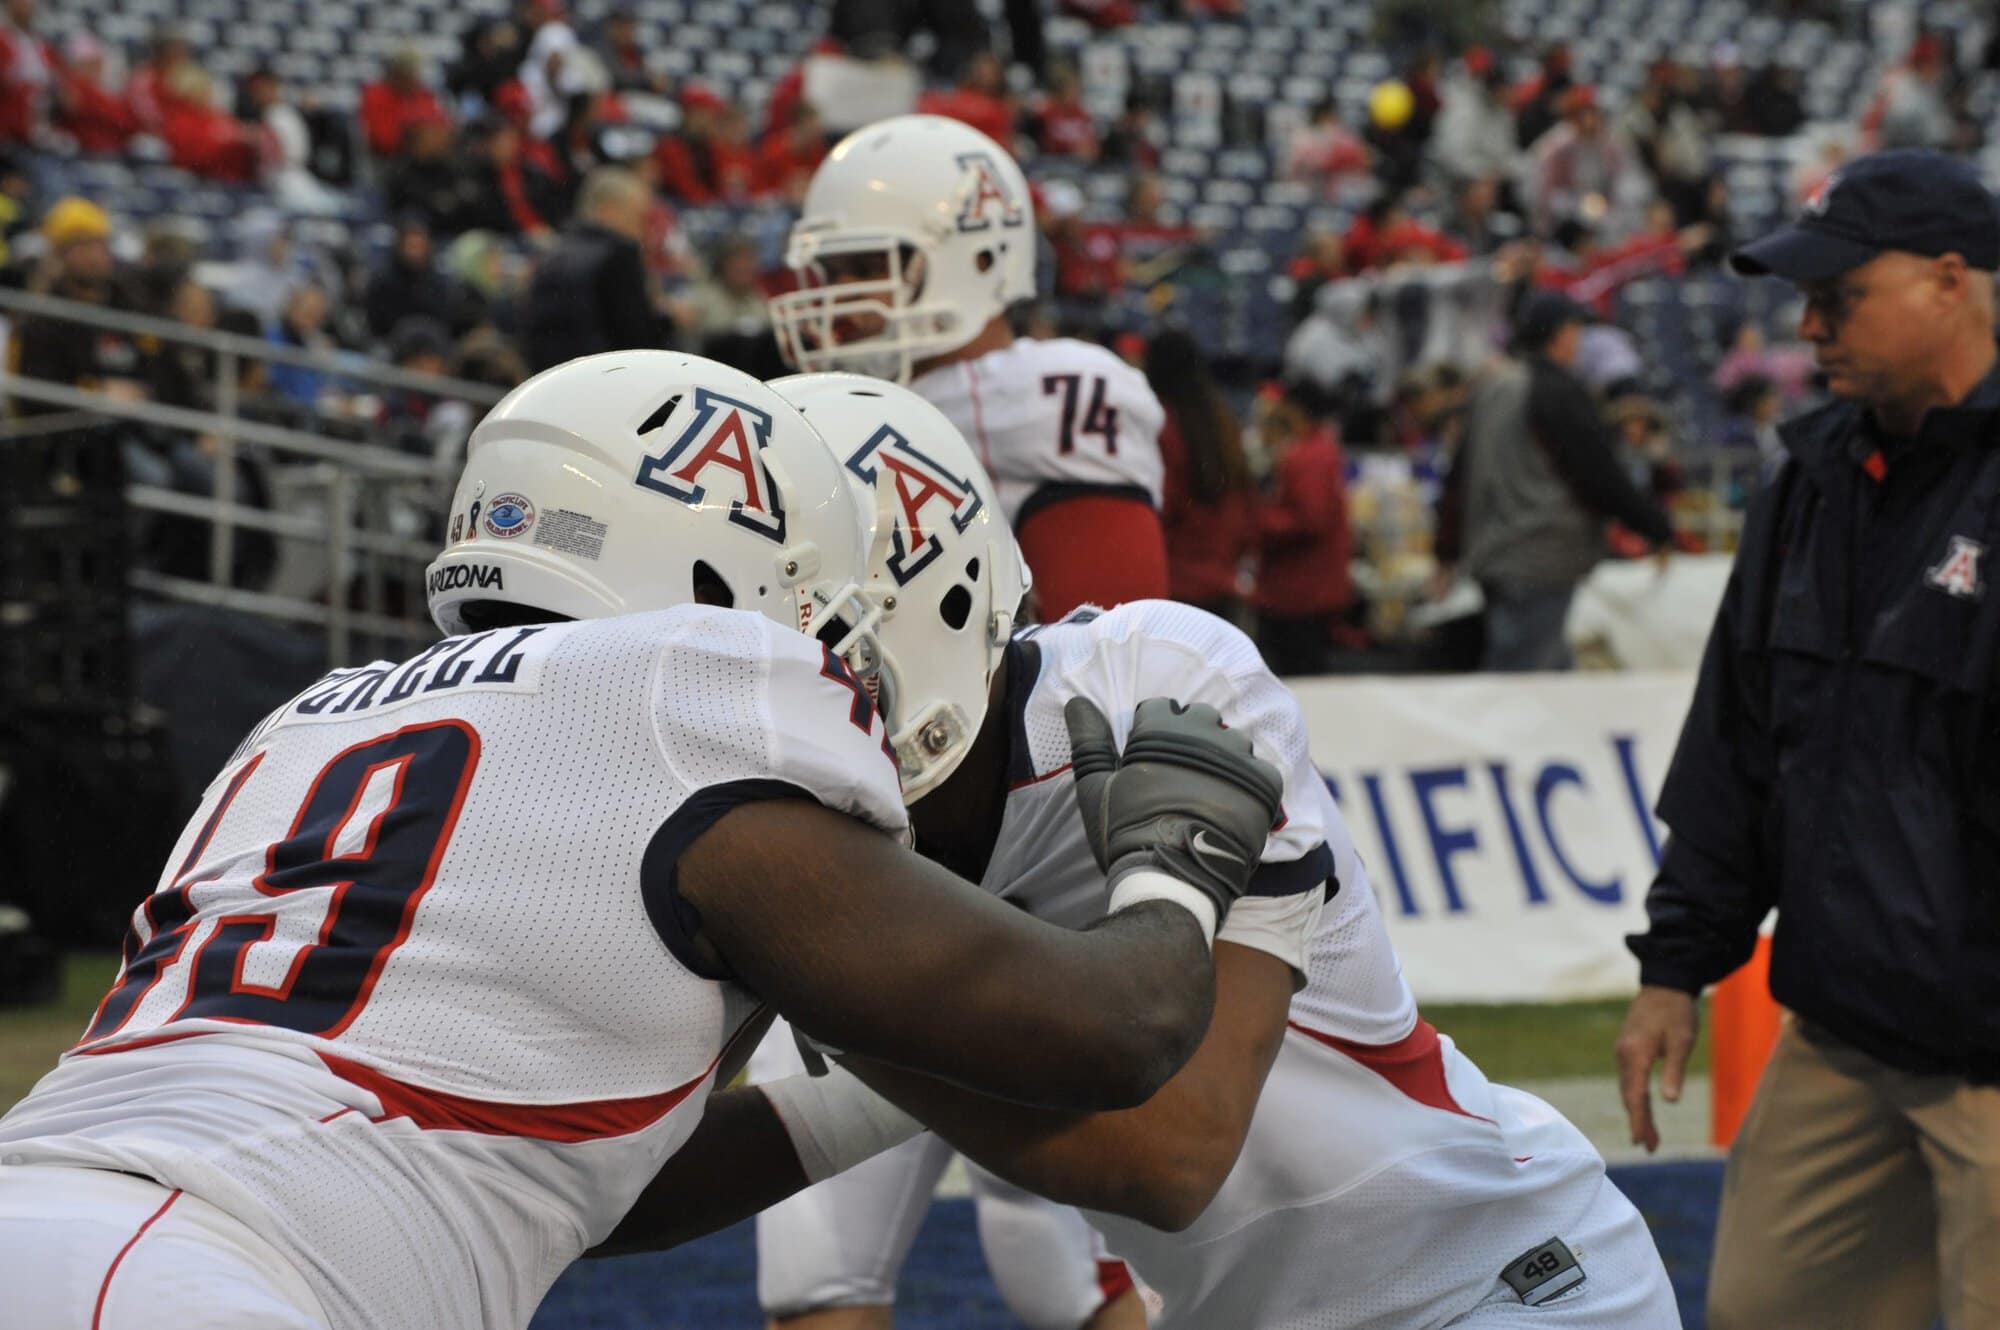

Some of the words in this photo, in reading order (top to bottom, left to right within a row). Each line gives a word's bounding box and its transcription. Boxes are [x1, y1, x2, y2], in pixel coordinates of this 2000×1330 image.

[955, 152, 1023, 233] A
[1042, 372, 1120, 457] 74
[633, 386, 787, 545] A
[492, 496, 515, 508] PACIFIC
[514, 496, 529, 510] LIFE
[508, 522, 528, 536] BOWL
[845, 423, 983, 588] A
[429, 564, 504, 596] ARIZONA
[1924, 534, 1985, 598] A
[1326, 758, 1624, 916] IFIC
[1523, 1251, 1560, 1280] 48
